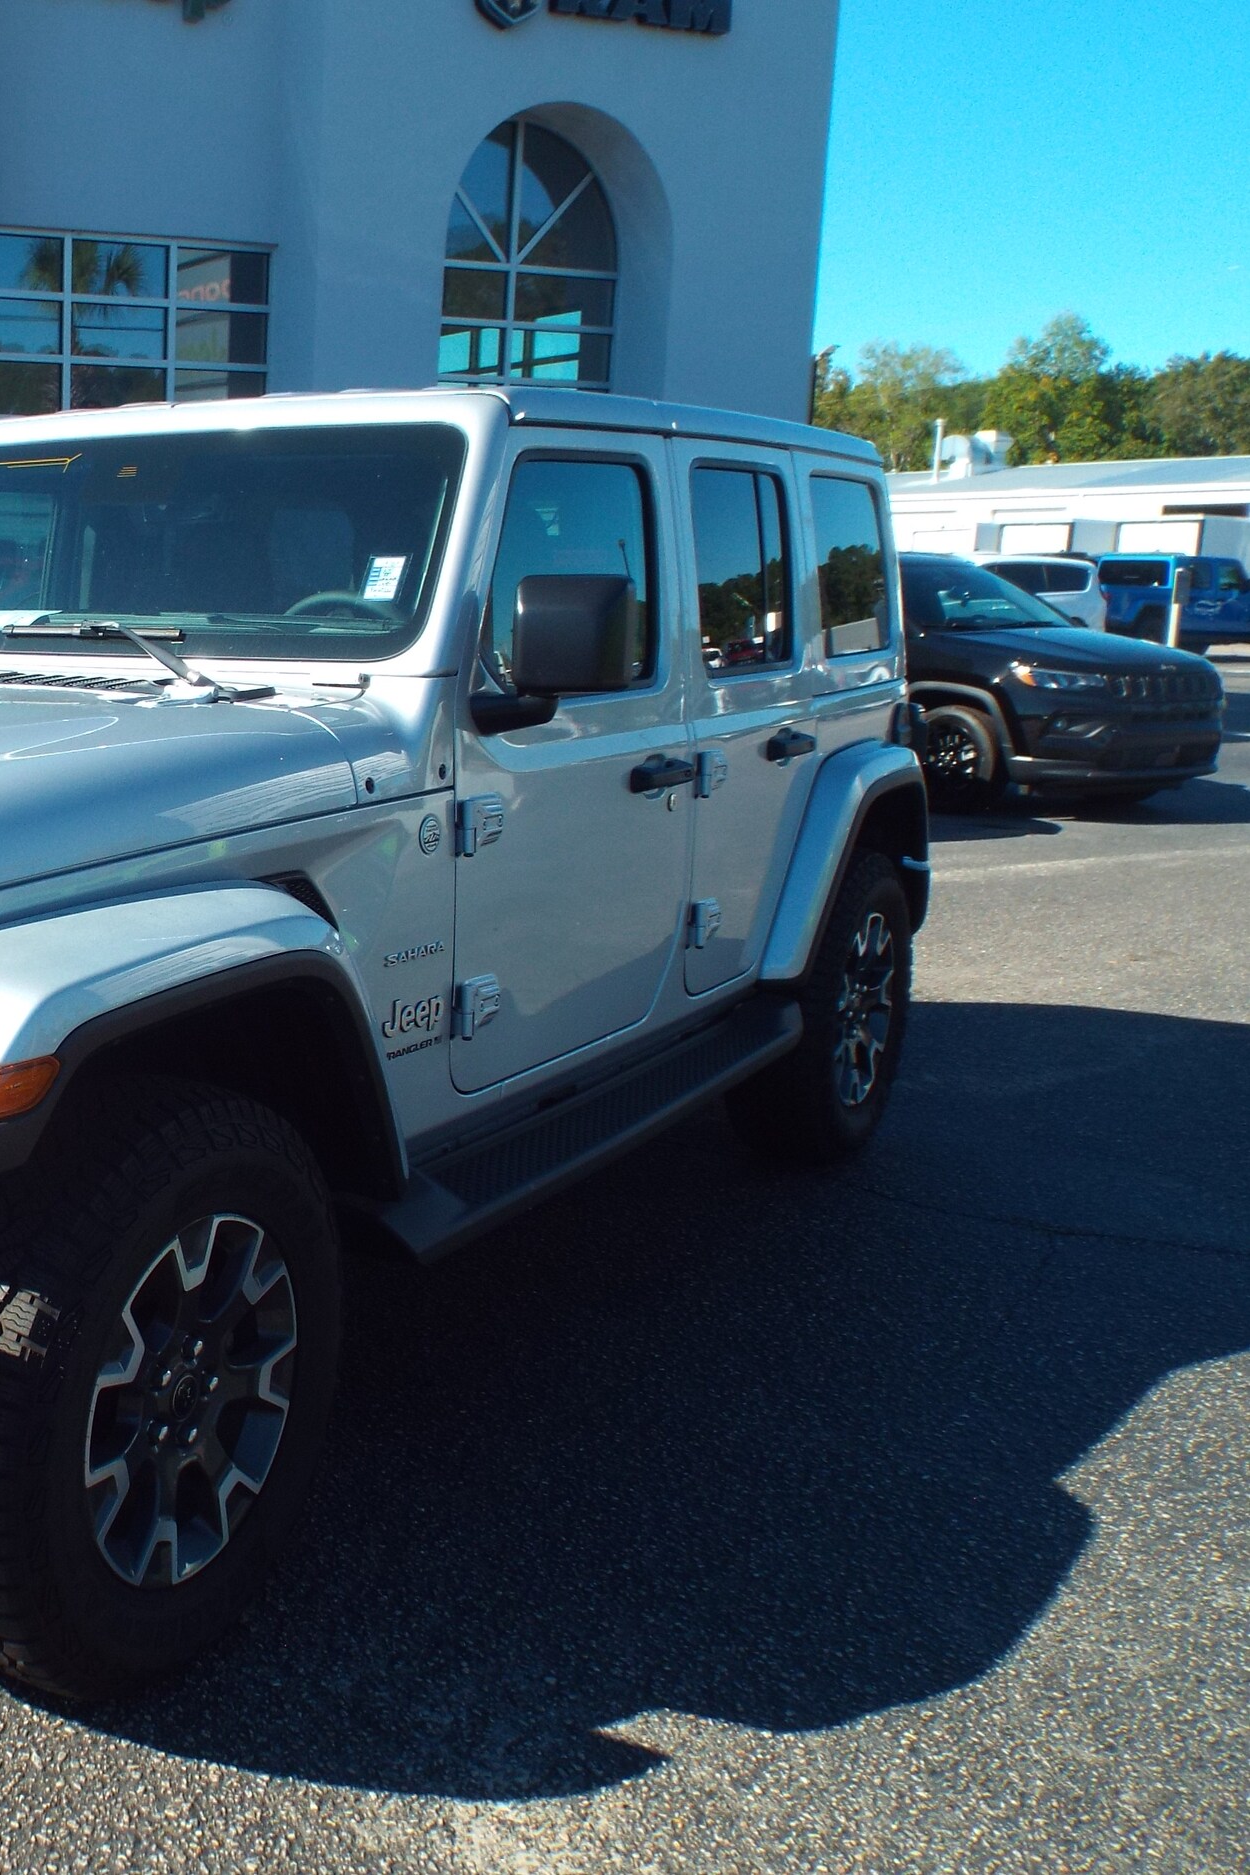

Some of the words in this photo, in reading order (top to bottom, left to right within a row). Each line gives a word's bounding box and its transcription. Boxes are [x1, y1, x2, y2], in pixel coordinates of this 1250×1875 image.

[547, 0, 731, 36] AM
[383, 941, 445, 967] SAHARA
[382, 995, 444, 1038] Jeep
